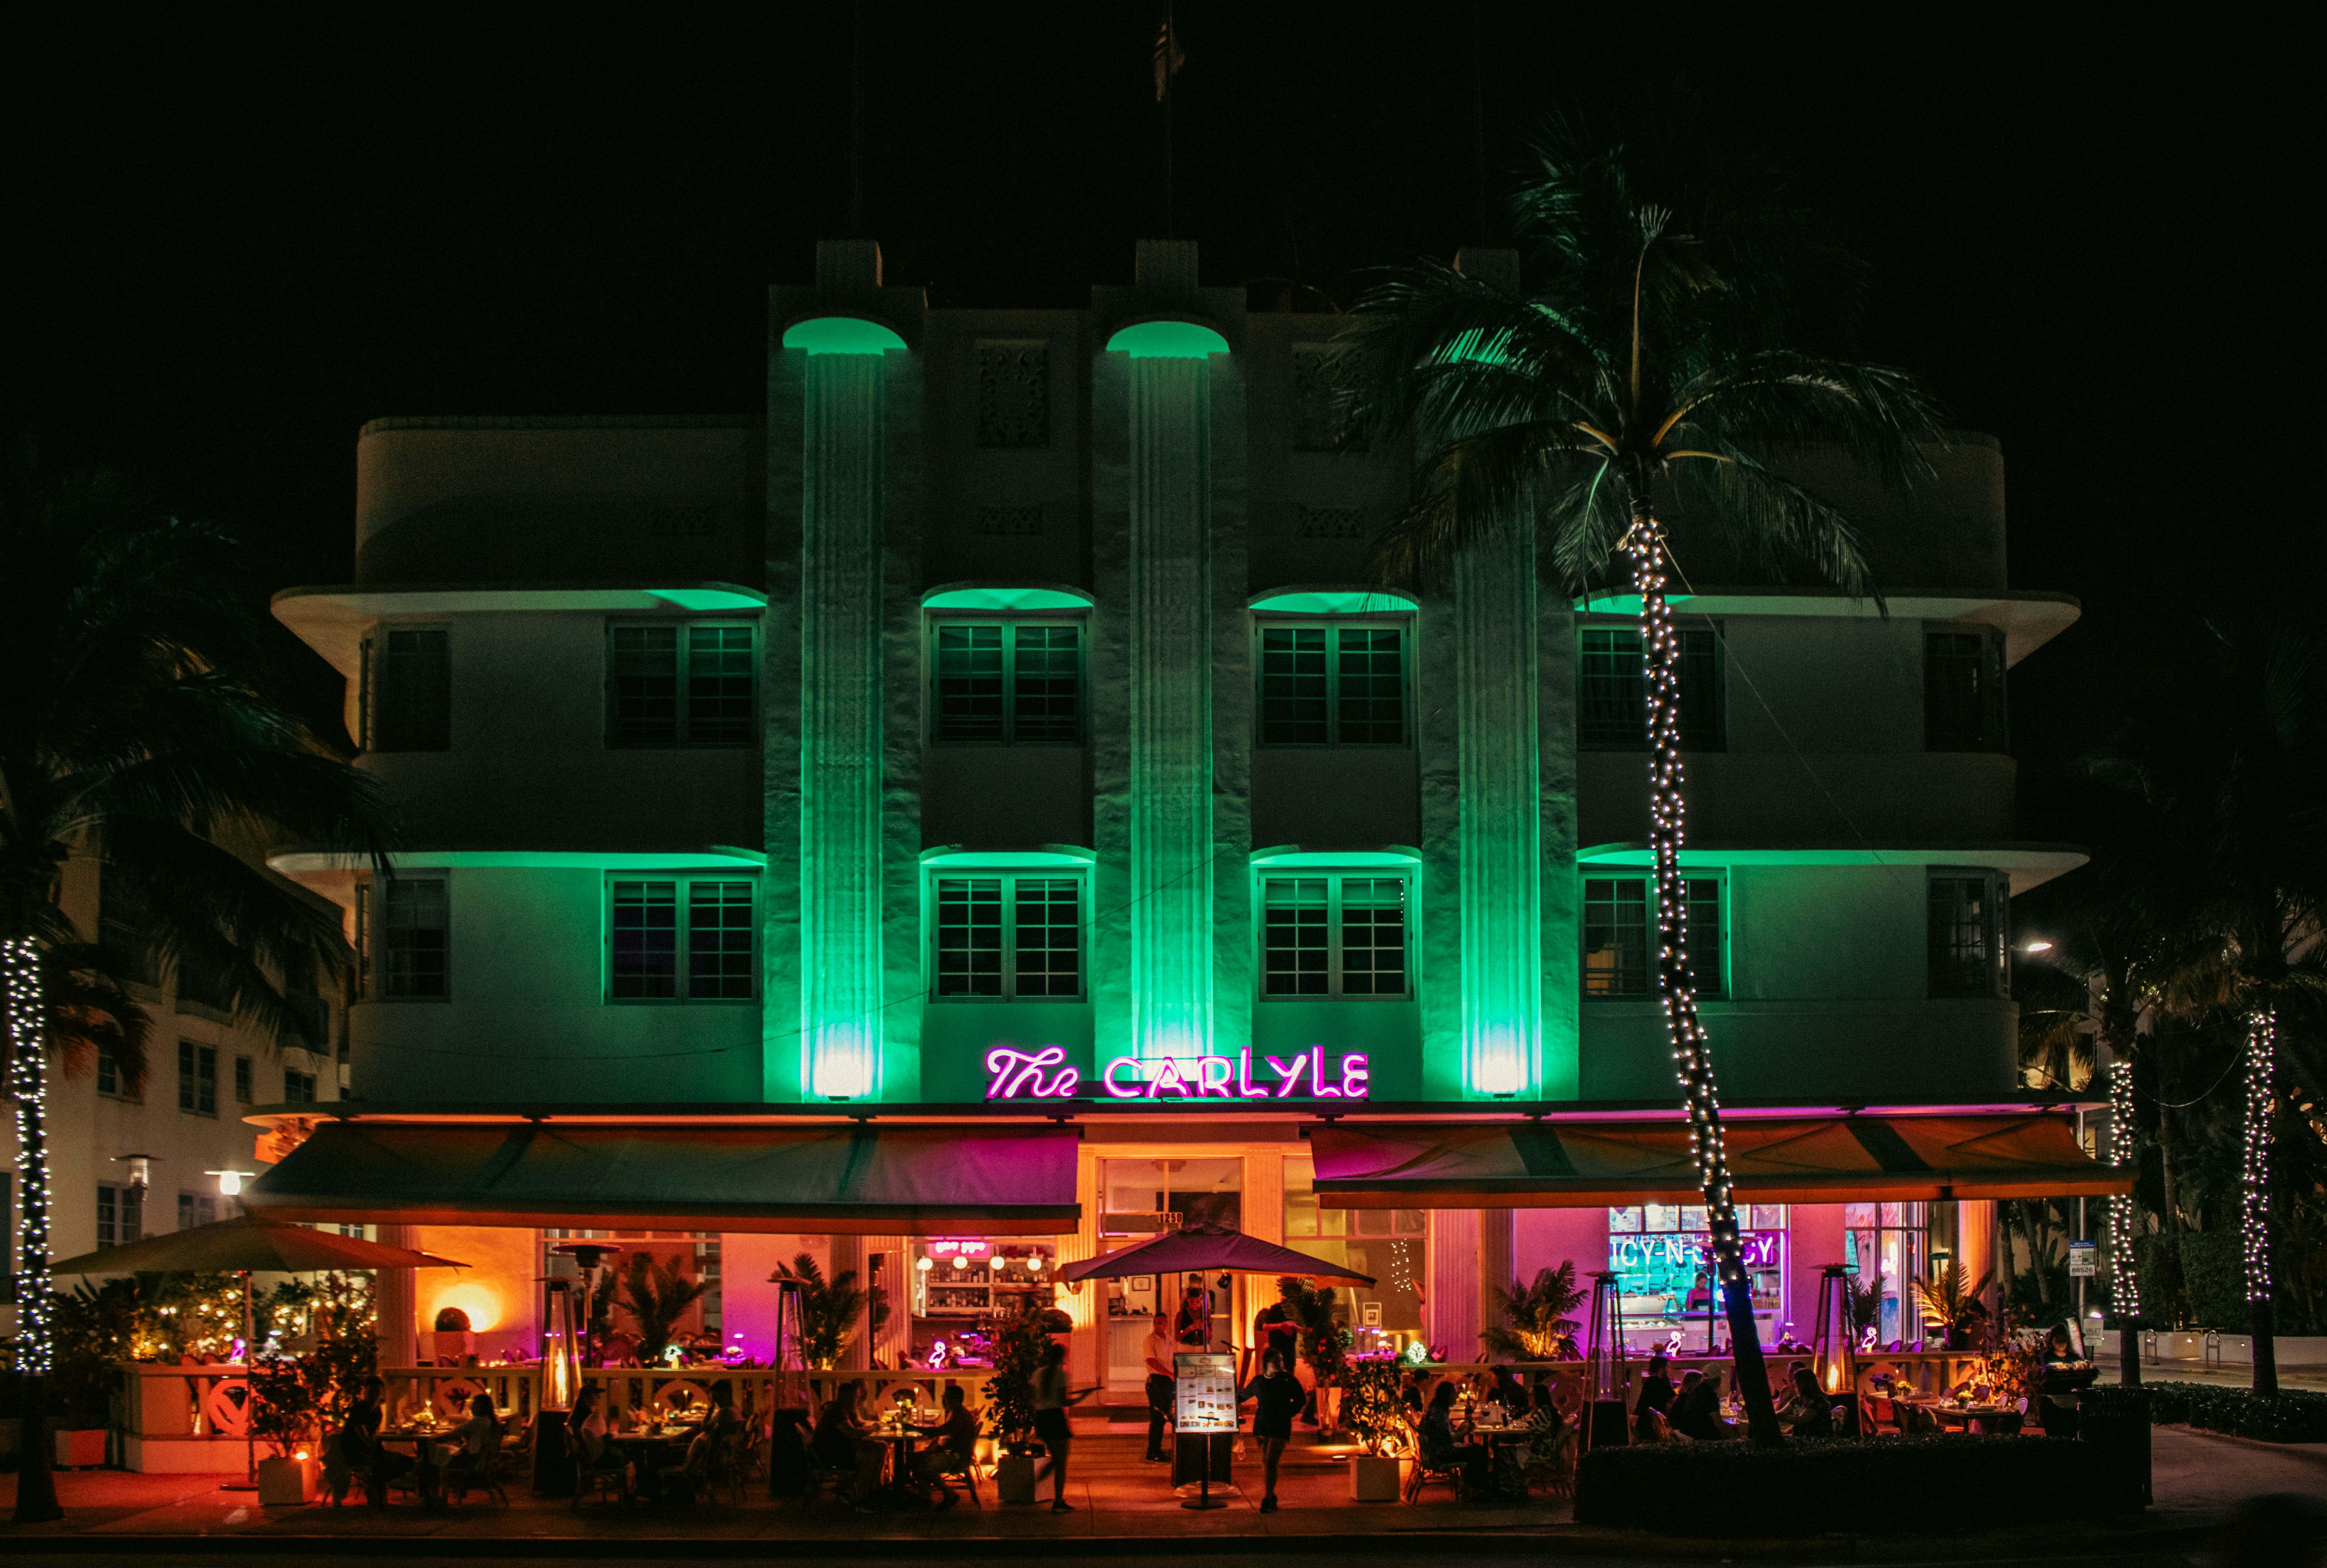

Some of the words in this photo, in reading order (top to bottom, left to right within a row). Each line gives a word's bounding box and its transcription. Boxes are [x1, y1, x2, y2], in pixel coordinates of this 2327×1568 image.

[986, 1046, 1078, 1098] The
[1103, 1046, 1368, 1098] CARLYLE
[1160, 1213, 1182, 1223] 1250
